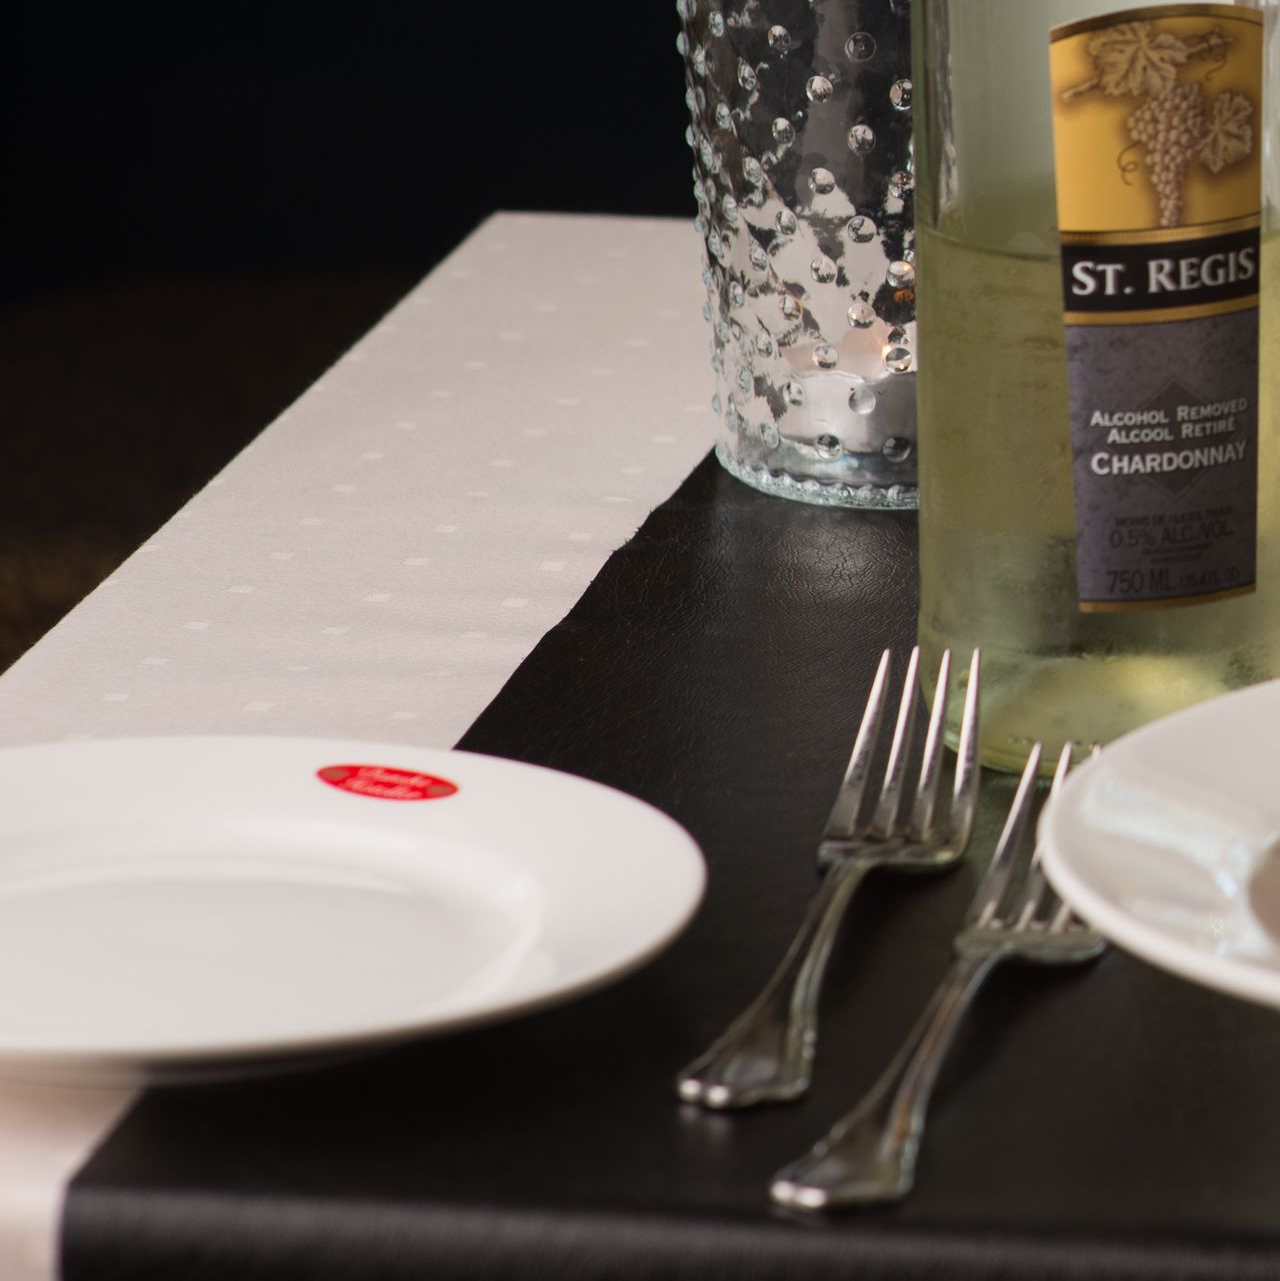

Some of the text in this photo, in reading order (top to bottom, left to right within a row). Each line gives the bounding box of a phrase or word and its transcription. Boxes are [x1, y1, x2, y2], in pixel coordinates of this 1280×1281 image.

[1071, 247, 1256, 296] ST. REGIS
[1090, 398, 1248, 427] ALCOHOL REMOVED
[1107, 416, 1236, 444] ALCOOL RETIRÉ
[1090, 440, 1248, 476] CHARDONNAY
[1107, 570, 1145, 594] 750
